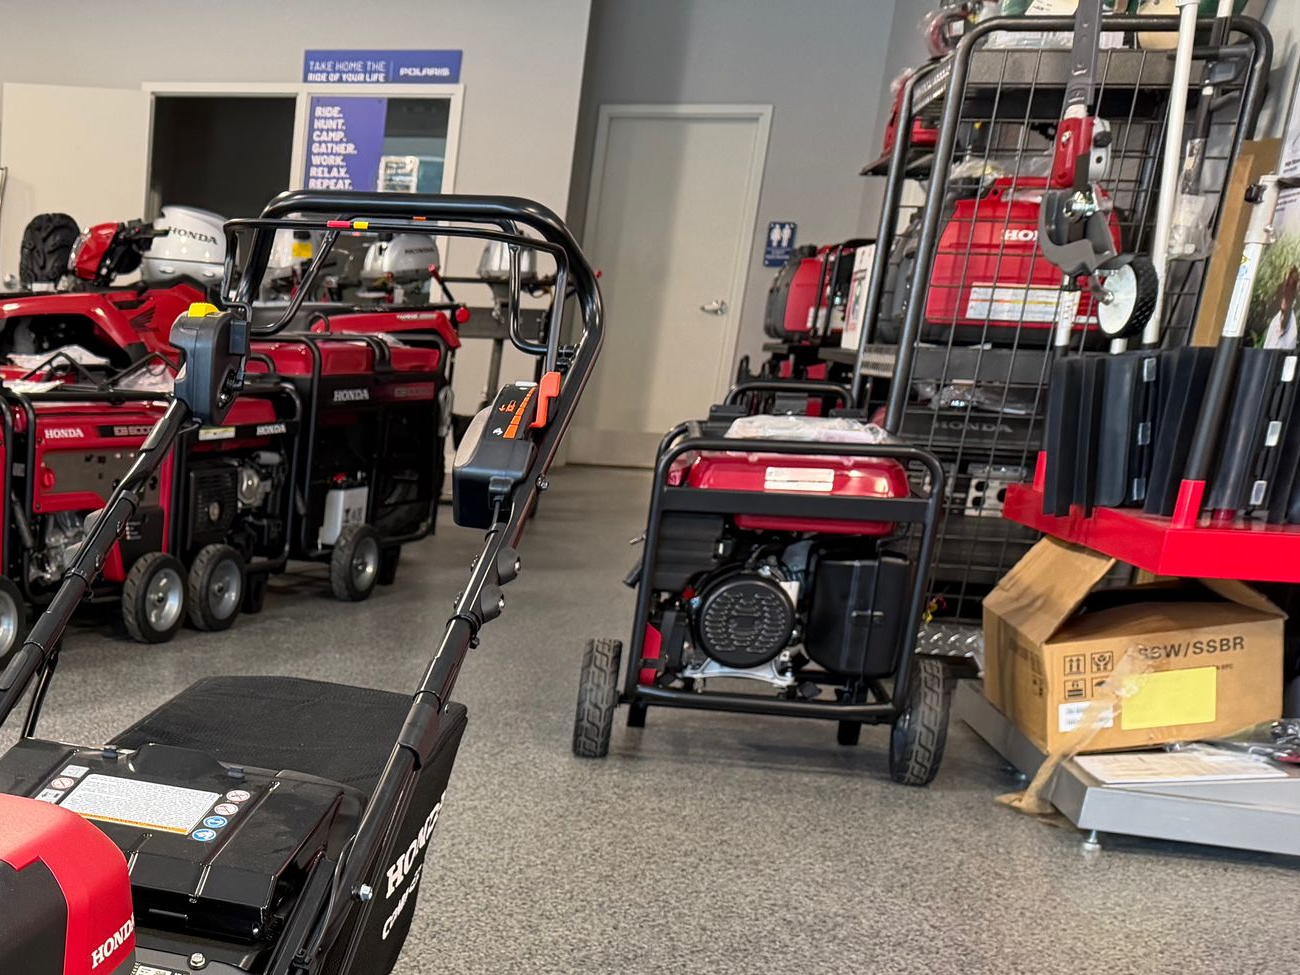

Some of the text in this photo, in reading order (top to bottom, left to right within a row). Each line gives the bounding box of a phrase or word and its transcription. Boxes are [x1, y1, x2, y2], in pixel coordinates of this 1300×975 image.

[309, 60, 387, 71] TAKE HOME THE
[307, 73, 385, 82] RIDE OF YOUR LIFE
[400, 67, 450, 77] POLARIS
[315, 106, 343, 117] RIDE.
[314, 118, 346, 130] HUNT.
[312, 130, 347, 142] CAMP.
[312, 143, 358, 155] GATHER.
[311, 154, 347, 166] WORK.
[309, 166, 350, 178] RELAX.
[308, 178, 353, 190] REPEAT.
[168, 225, 218, 246] HONDA
[333, 388, 370, 402] HONDA
[256, 423, 286, 436] HONDA
[934, 420, 1013, 433] HONDA
[44, 427, 84, 439] HONDA
[386, 789, 447, 900] HOND
